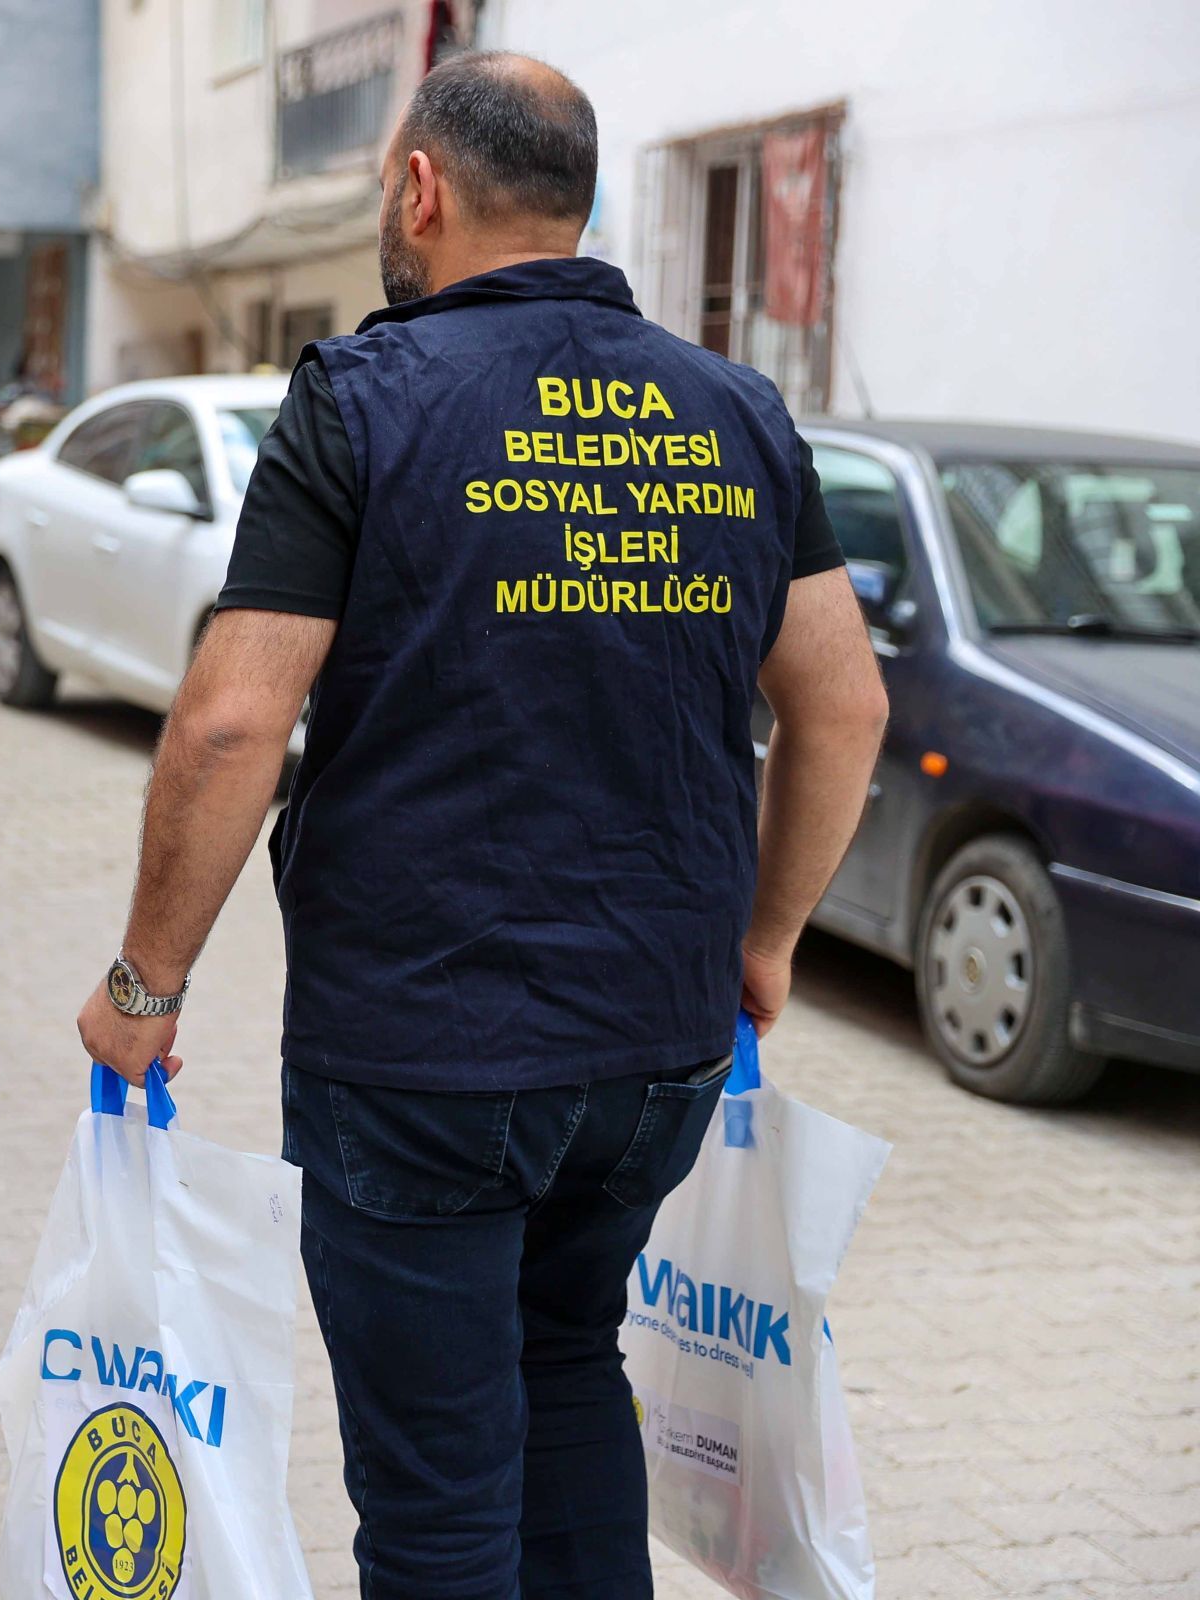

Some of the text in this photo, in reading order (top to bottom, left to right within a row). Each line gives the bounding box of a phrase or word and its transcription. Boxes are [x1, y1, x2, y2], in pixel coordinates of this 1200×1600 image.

[537, 377, 675, 419] BUCA
[504, 428, 721, 467] BELEDİYESİ
[465, 479, 756, 519] SOSYAL YARDIM
[564, 523, 679, 571] İŞLERİ
[496, 573, 732, 614] MÜDÜRLÜĞÜ
[41, 1328, 83, 1381] C
[86, 1416, 157, 1466] BUCA
[696, 1434, 738, 1461] DUMAN
[114, 1558, 135, 1574] 1923
